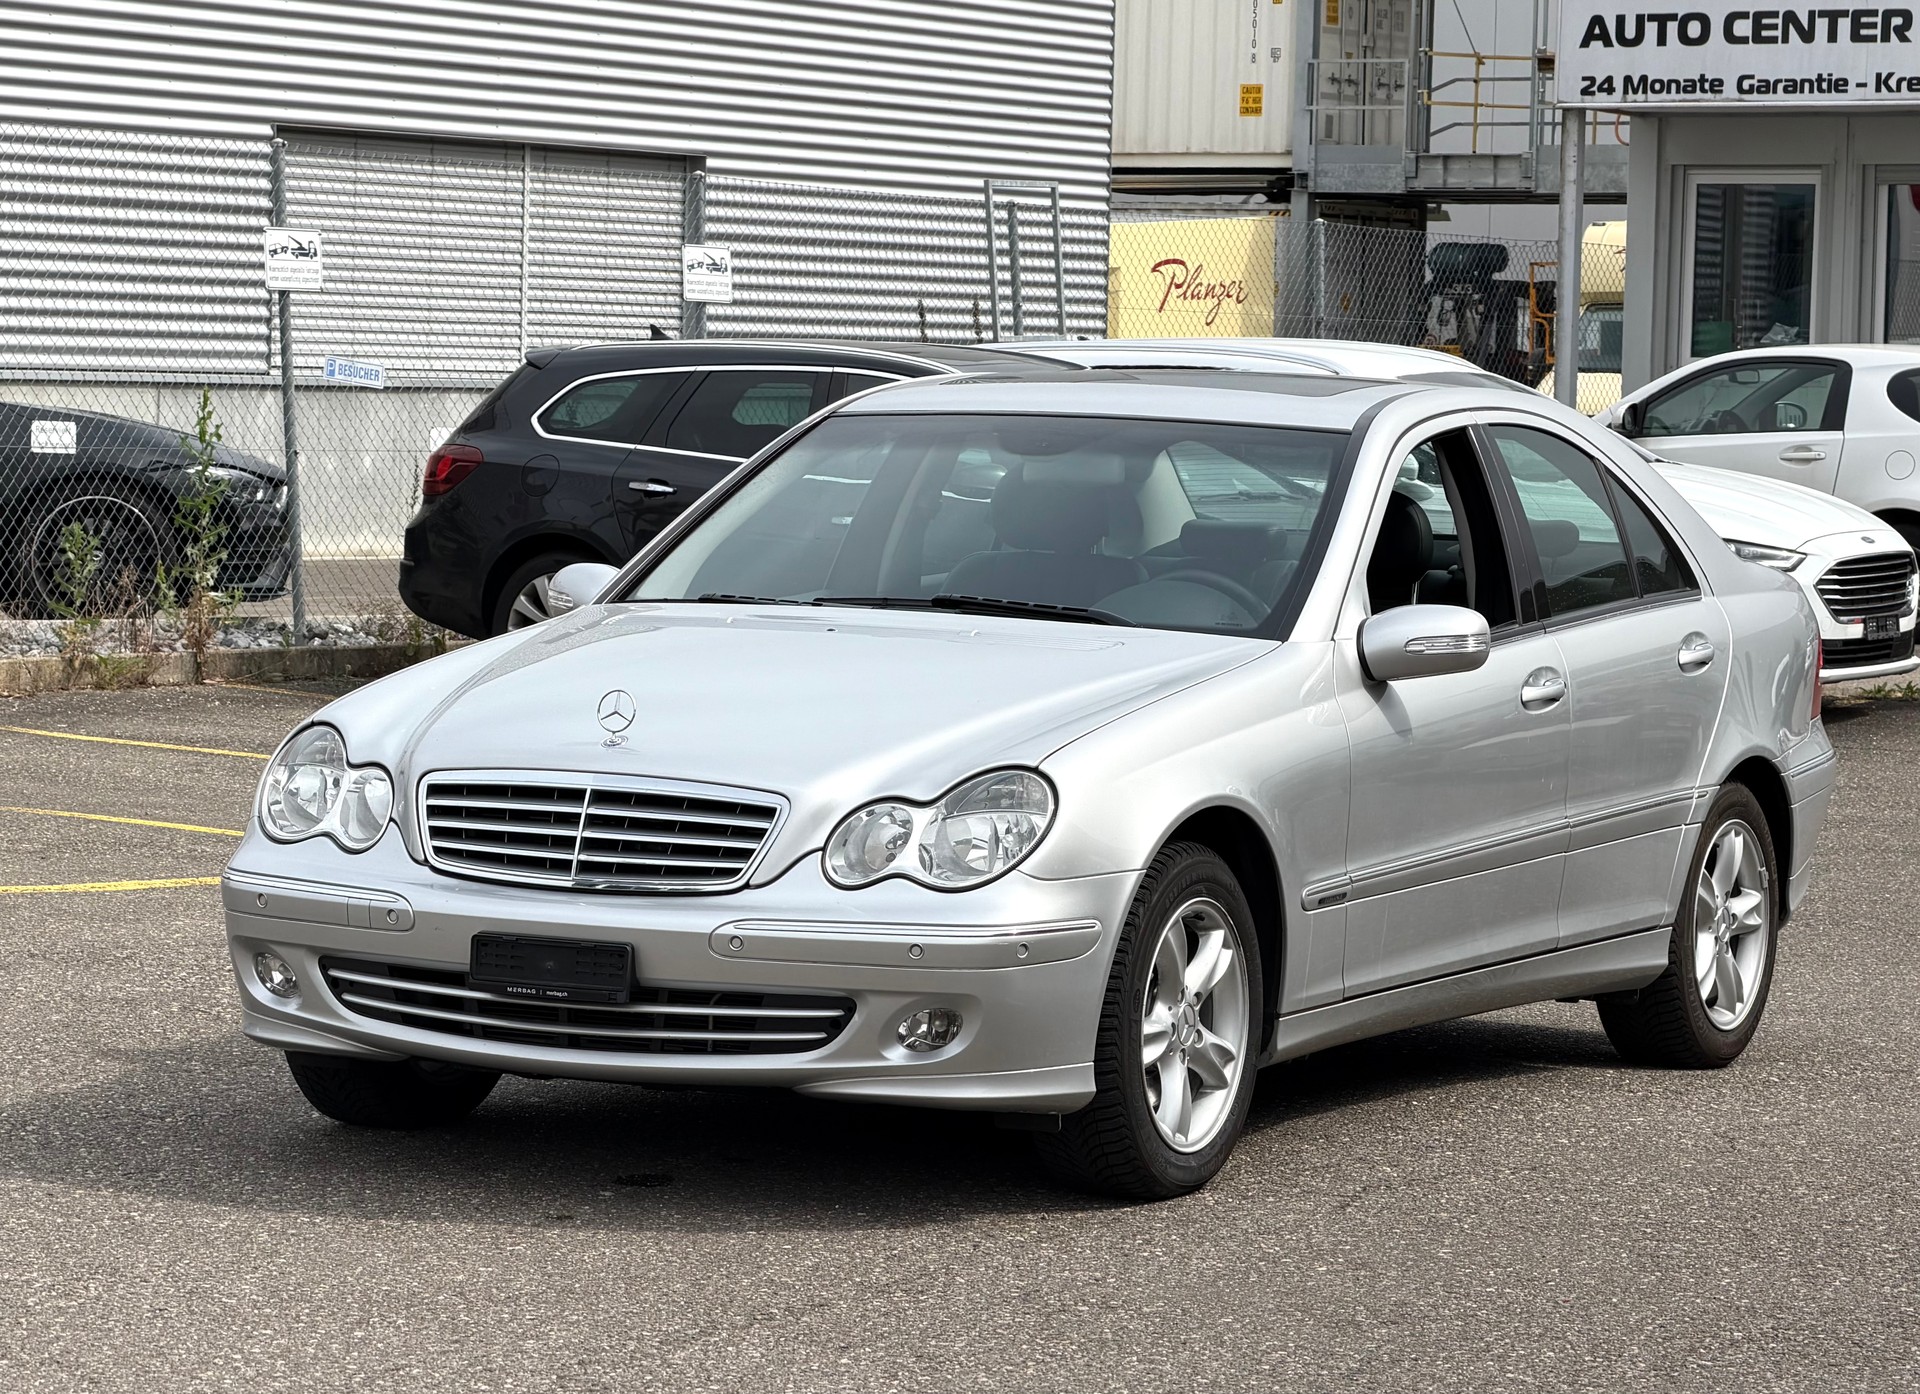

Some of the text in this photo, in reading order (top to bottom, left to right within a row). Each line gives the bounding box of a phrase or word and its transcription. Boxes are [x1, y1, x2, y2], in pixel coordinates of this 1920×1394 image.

[1579, 8, 1913, 49] AUTO CENTER
[1580, 75, 1616, 96] 24
[1622, 73, 1724, 95] Monate
[1736, 72, 1849, 95] Garantie
[1151, 258, 1249, 326] Planzer
[338, 363, 380, 382] BESUCHER
[507, 986, 536, 994] MERBAG
